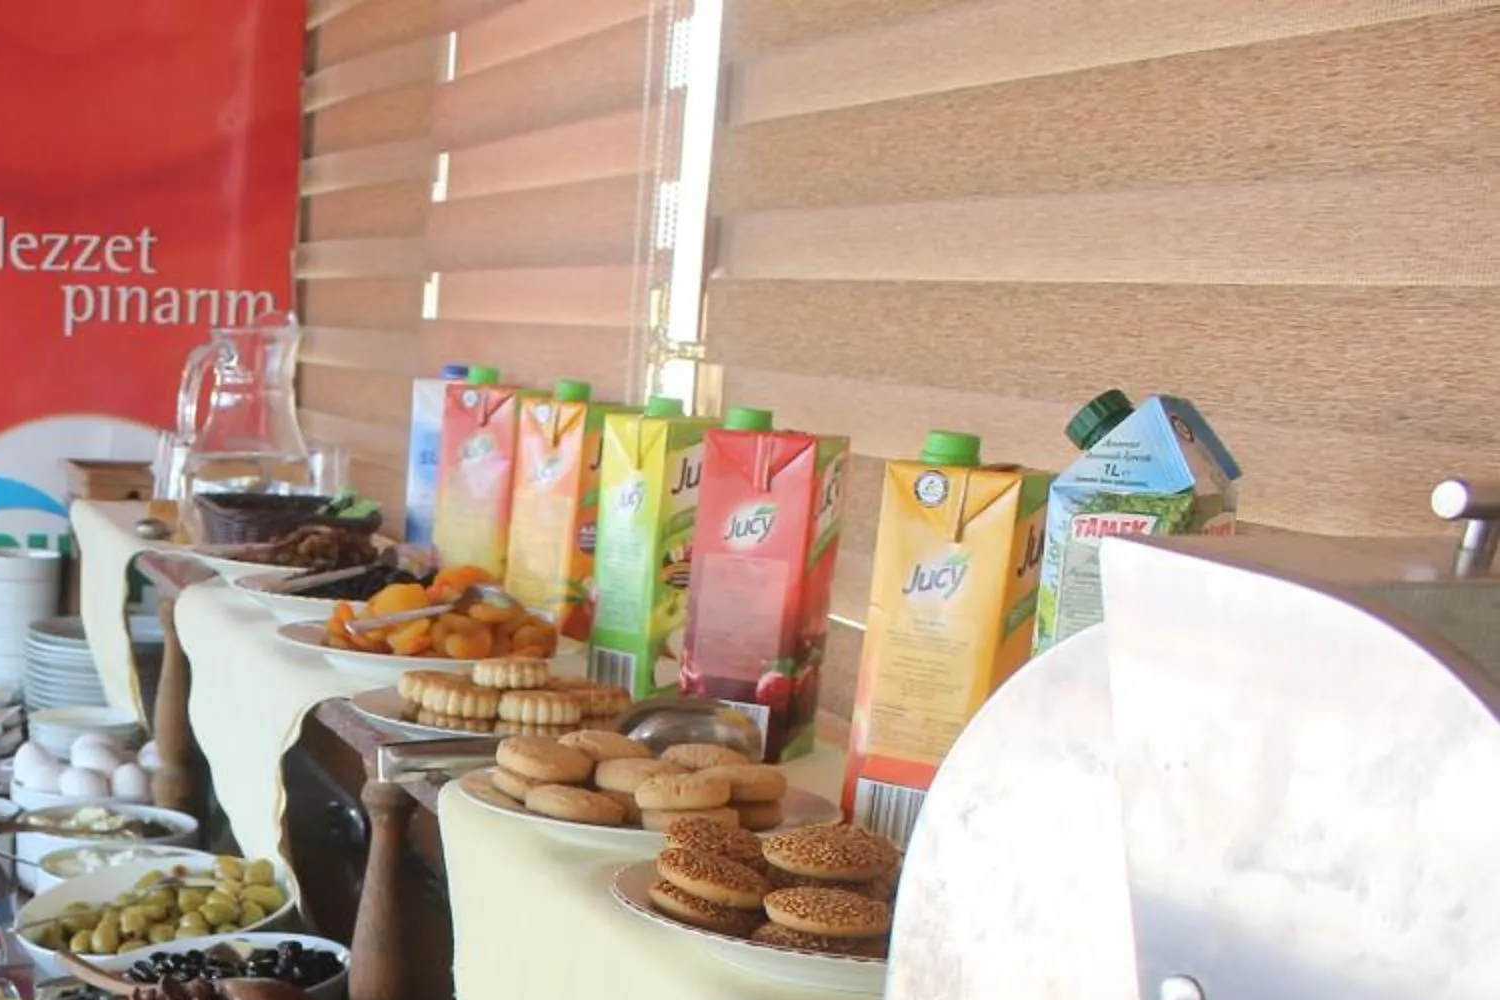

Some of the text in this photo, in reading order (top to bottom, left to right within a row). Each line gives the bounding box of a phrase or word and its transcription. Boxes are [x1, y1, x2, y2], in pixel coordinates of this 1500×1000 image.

[670, 457, 701, 495] Ju
[723, 514, 774, 544] Jucy
[1016, 524, 1045, 577] Ju
[901, 562, 969, 600] Jucy
